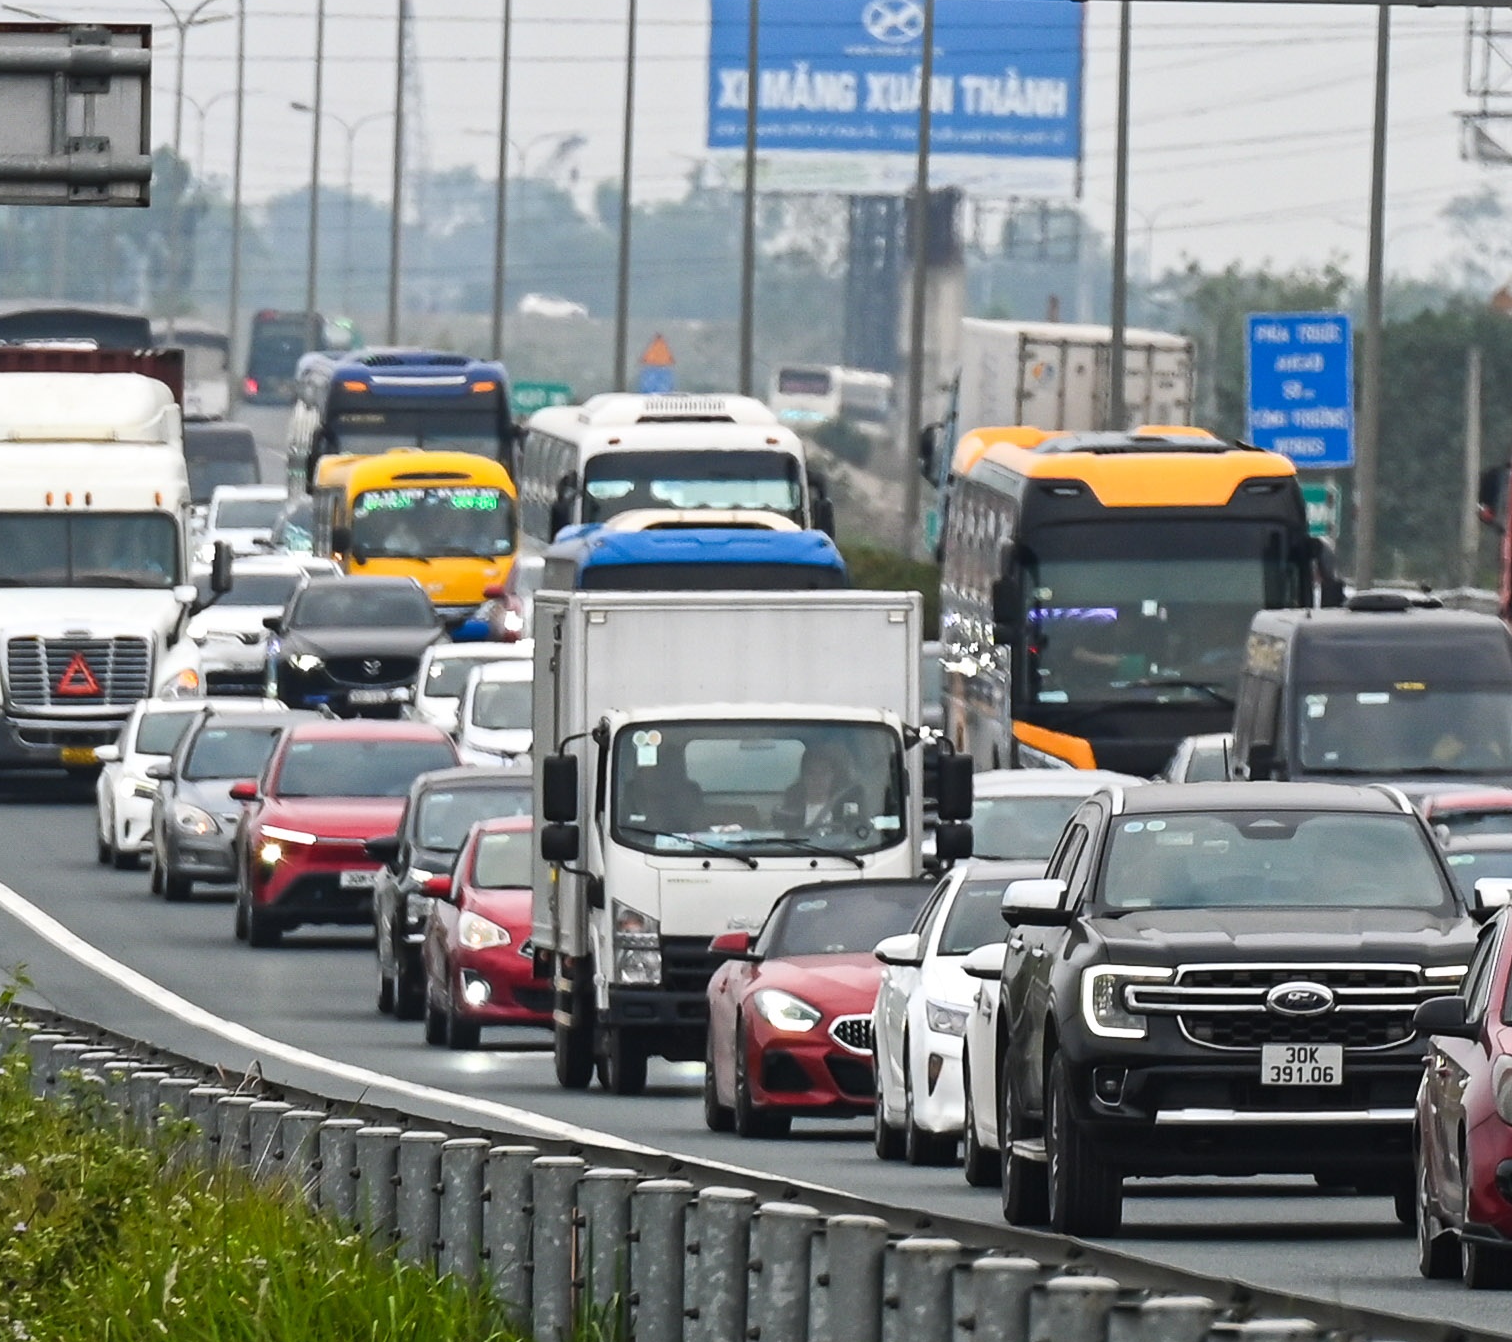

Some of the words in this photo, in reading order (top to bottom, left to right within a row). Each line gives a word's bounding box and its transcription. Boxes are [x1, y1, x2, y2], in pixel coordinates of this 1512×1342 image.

[758, 60, 856, 112] MĂNG
[960, 66, 1068, 117] THÀNH
[1285, 1046, 1319, 1064] 30K
[1270, 1065, 1334, 1083] 391.06
